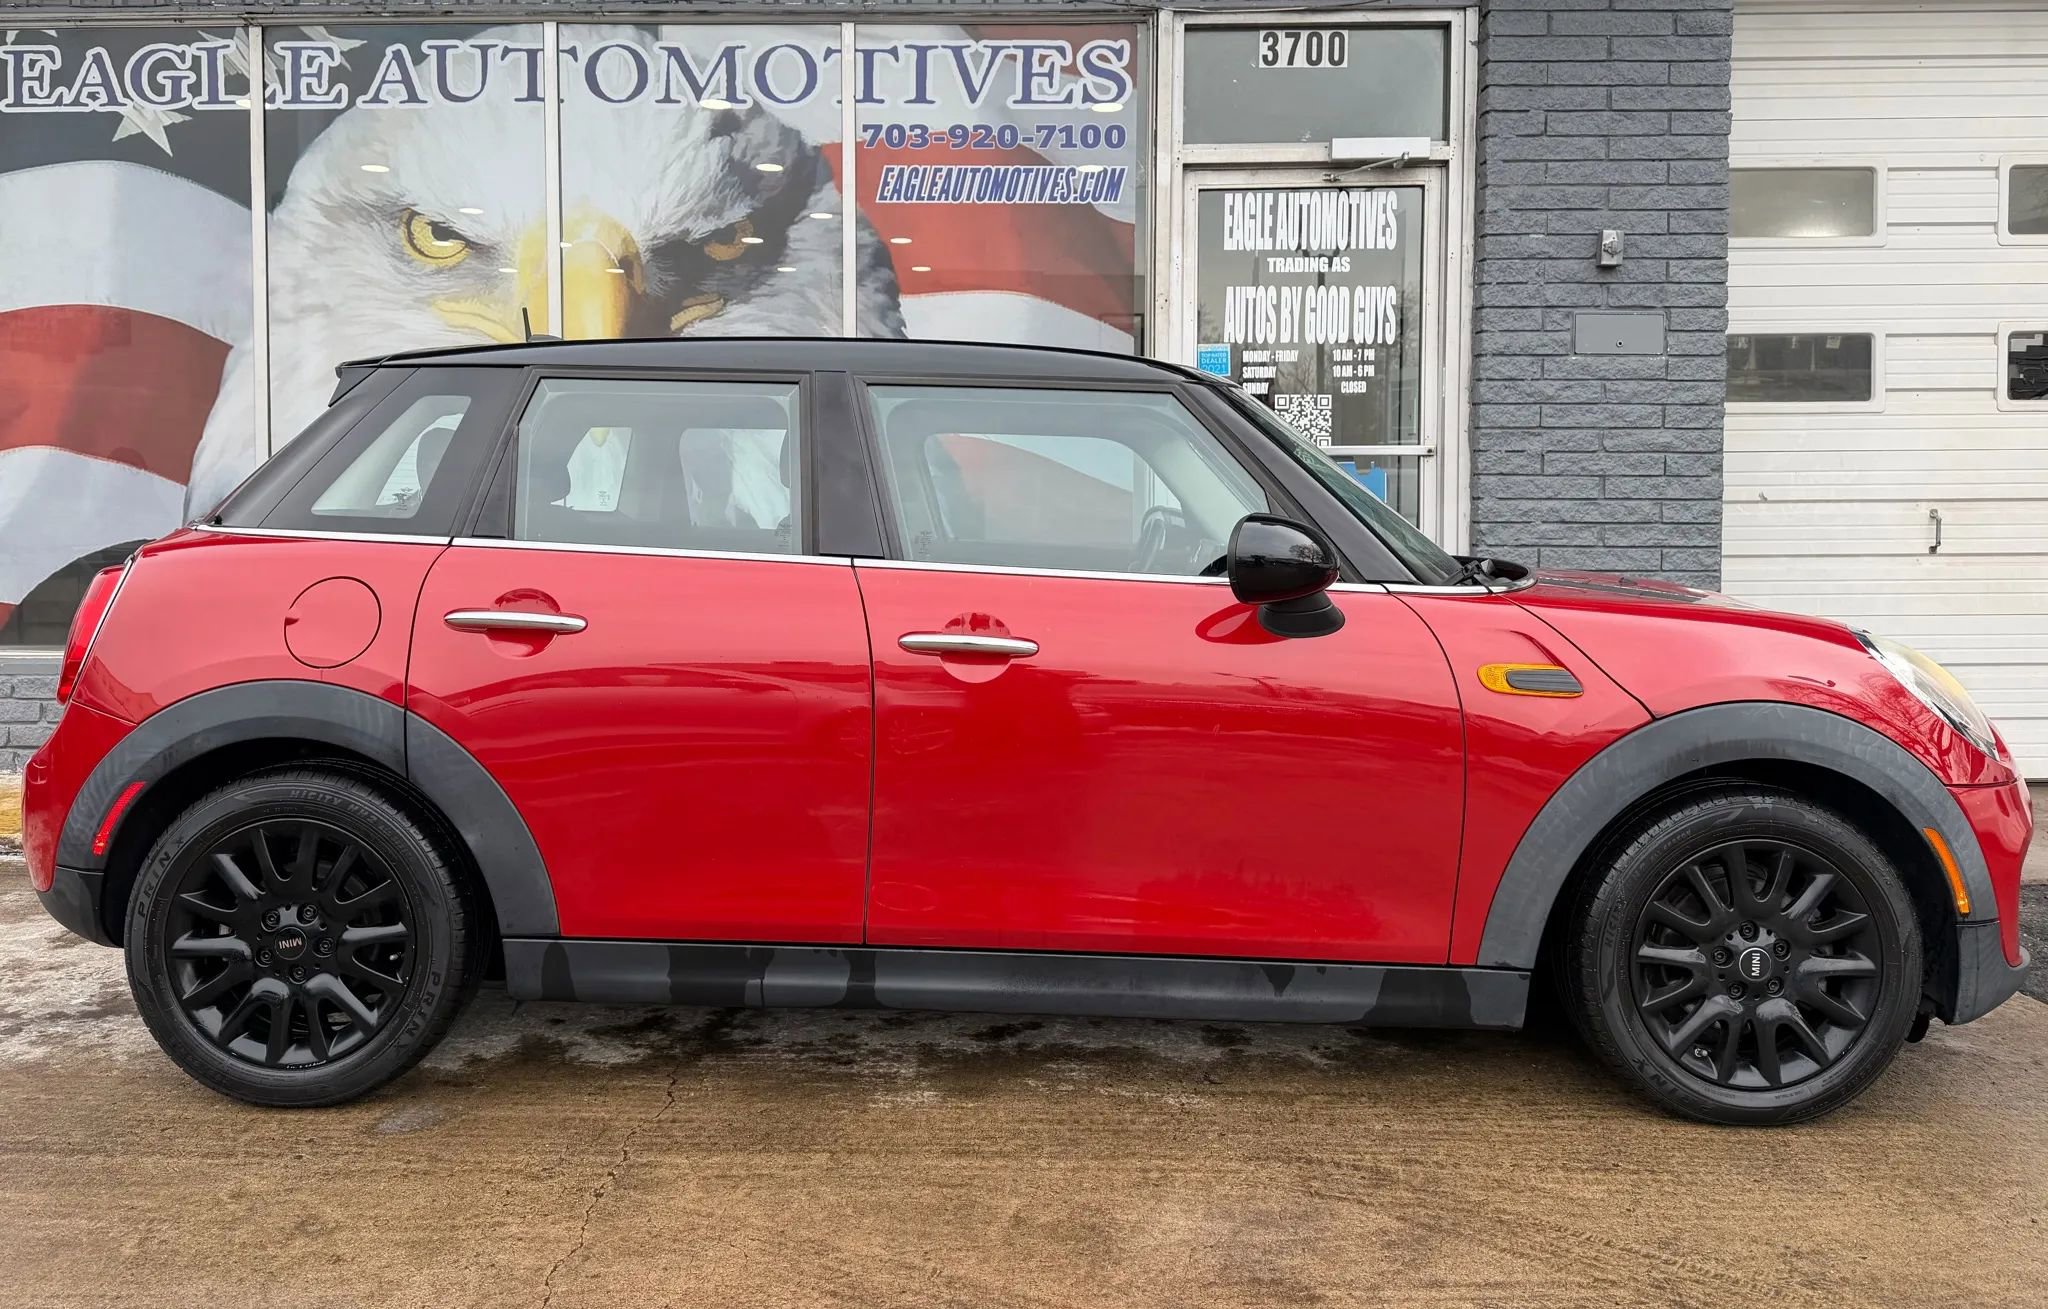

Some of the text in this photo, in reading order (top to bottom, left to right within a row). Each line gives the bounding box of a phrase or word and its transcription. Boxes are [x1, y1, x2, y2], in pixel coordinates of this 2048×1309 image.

[1262, 31, 1346, 66] 3700
[2, 42, 1128, 109] EAGLE AUTOMOTIVES
[861, 123, 1127, 149] 703-920-7100
[878, 165, 1127, 202] EAGLEAUTOMOTIVES.COM
[1224, 190, 1398, 250] EAGLE AUTOMOTIVES
[1267, 256, 1350, 272] TRADING AS
[1224, 285, 1397, 344] AUTOS BY GOOD GUYS
[1242, 350, 1271, 363] MONDAY
[1275, 350, 1299, 362] FRIDAY
[1332, 349, 1341, 361] 10
[1341, 349, 1353, 361] AM
[1357, 349, 1362, 361] 7
[1363, 349, 1375, 361] PM
[1202, 364, 1227, 374] 2021
[1242, 366, 1276, 379] SATURDAY
[1332, 365, 1341, 377] 10
[1341, 365, 1353, 377] AM
[1357, 365, 1363, 377] 6
[1363, 365, 1375, 377] PM
[1242, 382, 1269, 394] SUNDAY
[1340, 381, 1367, 393] CLOSED
[279, 937, 302, 950] MINI
[1751, 952, 1761, 976] MINI
